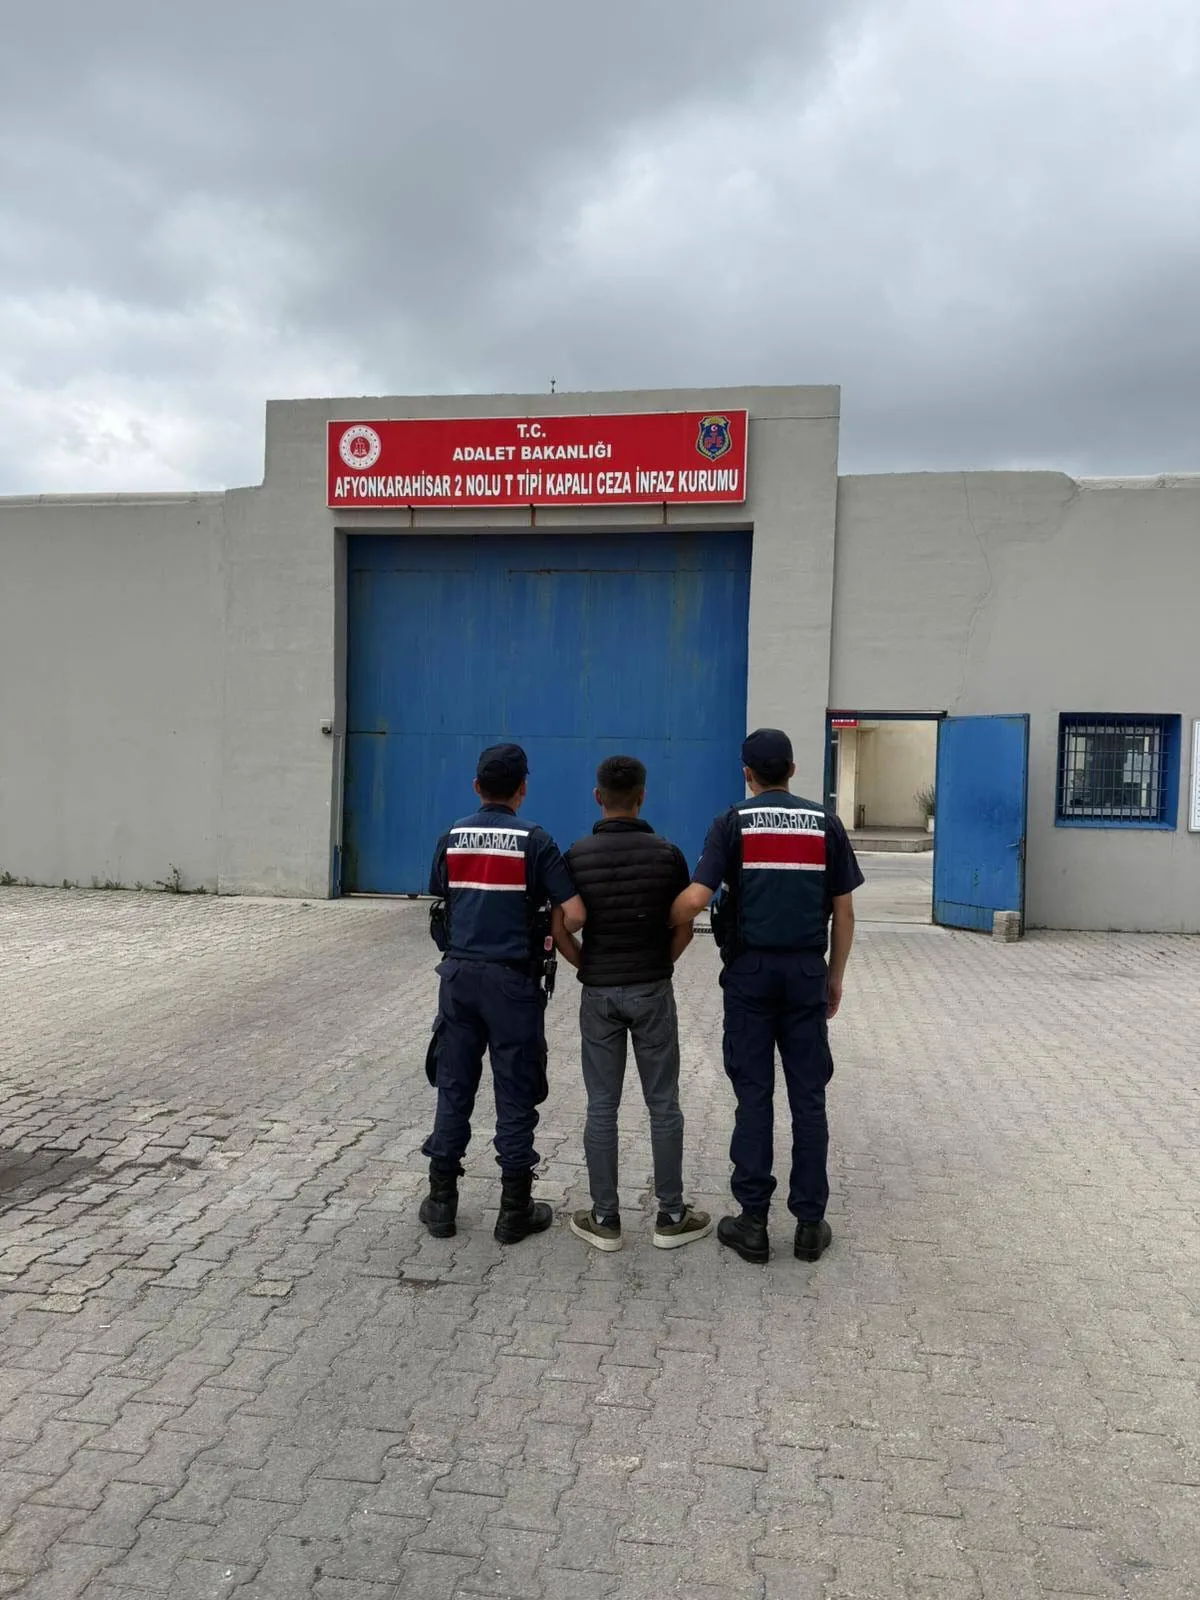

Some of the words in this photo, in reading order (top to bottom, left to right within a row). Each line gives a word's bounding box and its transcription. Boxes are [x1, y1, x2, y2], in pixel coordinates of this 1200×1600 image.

[517, 423, 546, 438] T.C.
[452, 447, 516, 461] ADALET
[521, 441, 612, 460] BAKANLIĞI
[334, 470, 451, 498] AFYONKARAHİSAR
[454, 475, 462, 497] 2
[466, 474, 501, 496] NOLU
[504, 474, 513, 496] T
[517, 468, 542, 497] TİPİ
[546, 472, 593, 496] KAPALI
[596, 471, 632, 495] CEZA
[635, 466, 675, 494] İNFAZ
[678, 469, 739, 493] KURUMU
[749, 812, 819, 830] JANDARMA
[454, 832, 518, 850] JANDARMA
